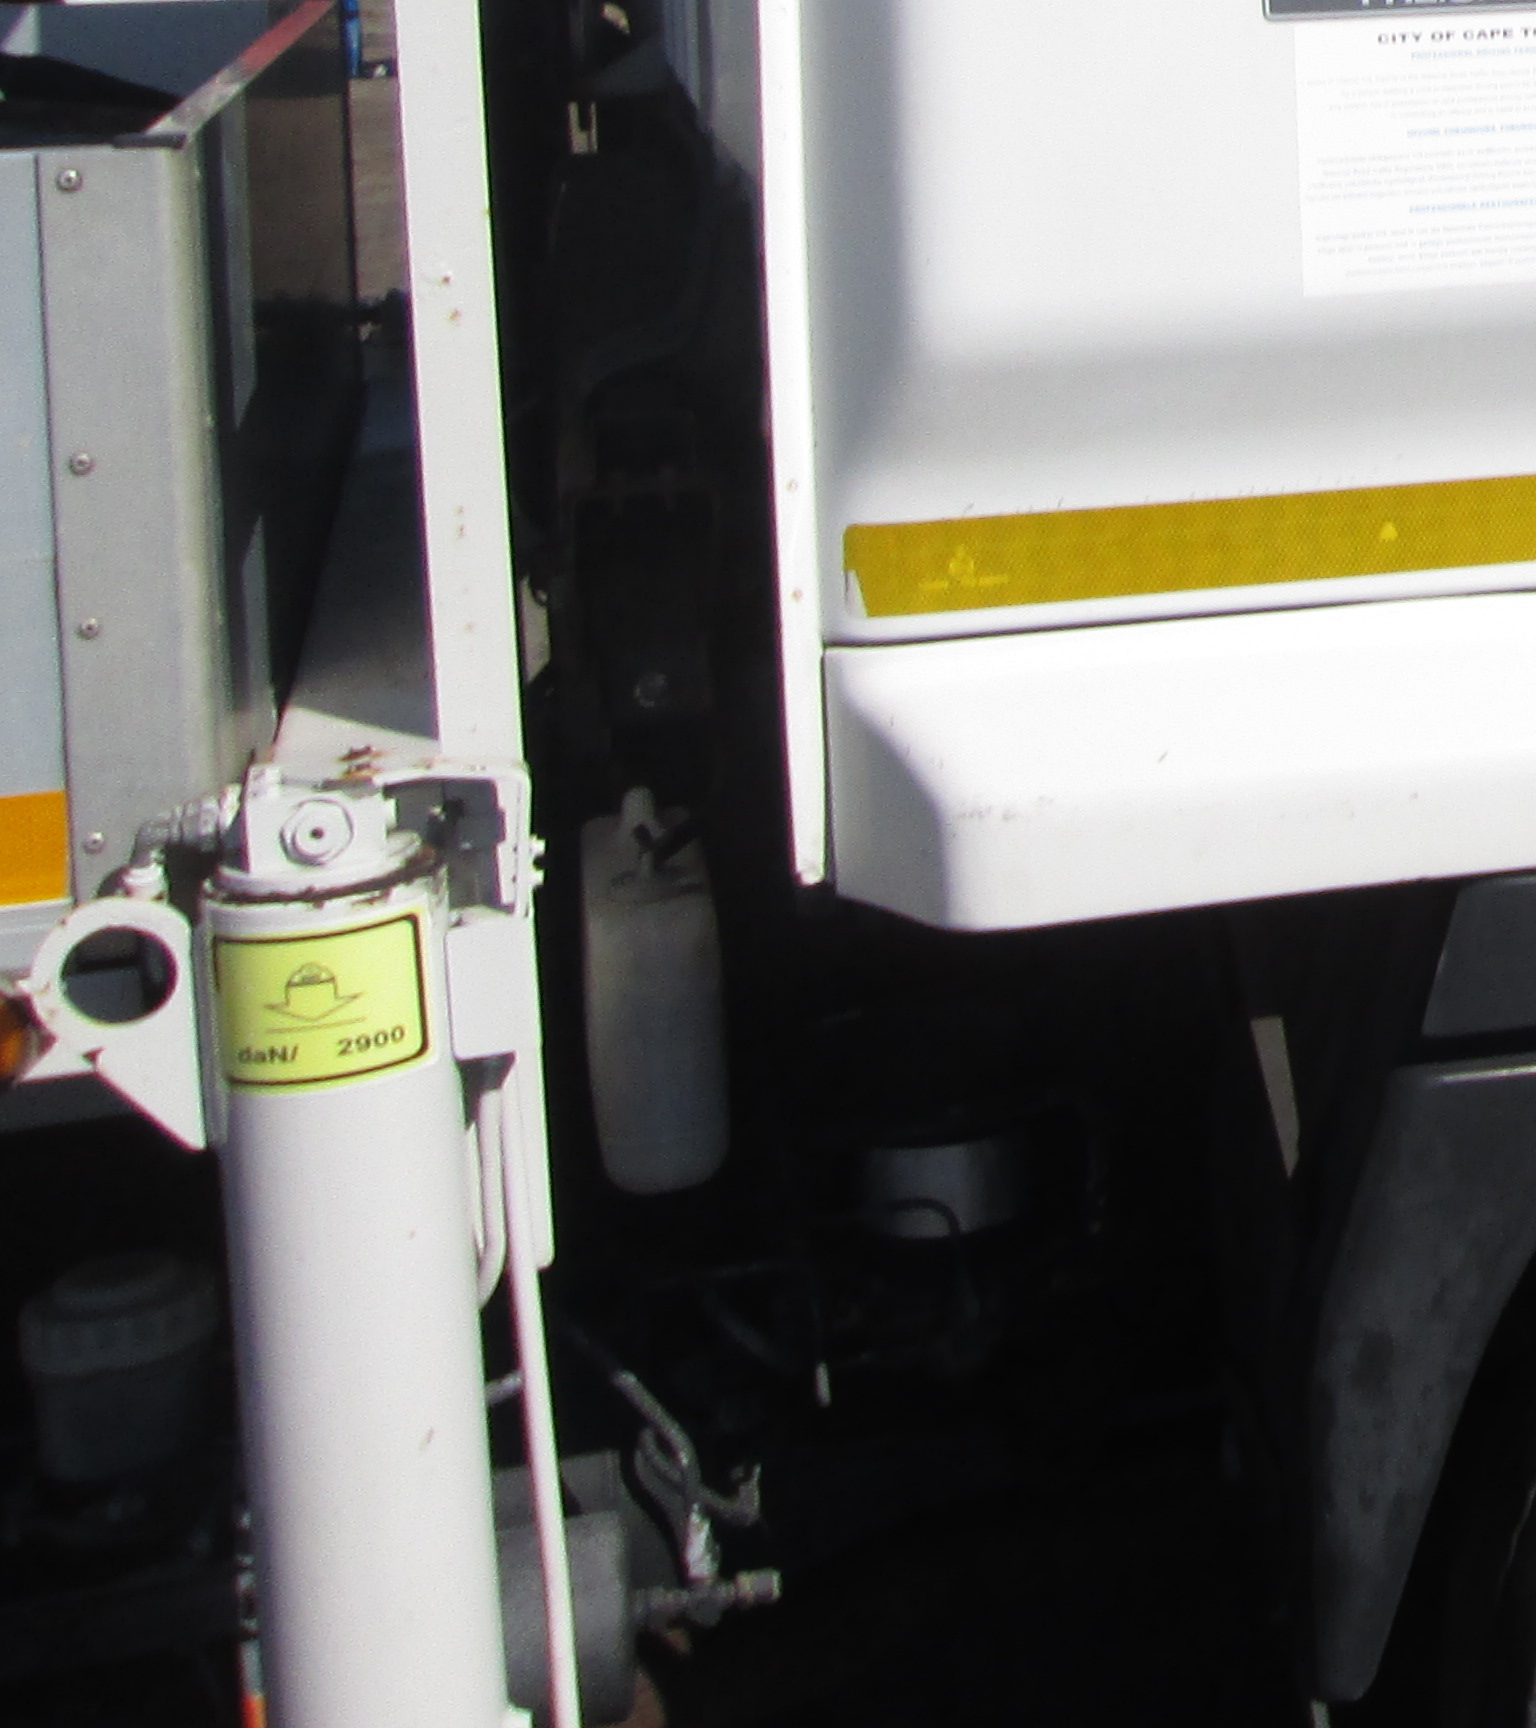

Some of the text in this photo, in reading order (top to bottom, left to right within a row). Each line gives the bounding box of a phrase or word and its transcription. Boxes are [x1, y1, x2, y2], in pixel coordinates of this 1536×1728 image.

[1377, 30, 1423, 46] CITY
[1430, 28, 1456, 43] OF
[1462, 26, 1514, 42] CAPE
[338, 1026, 406, 1057] 2900
